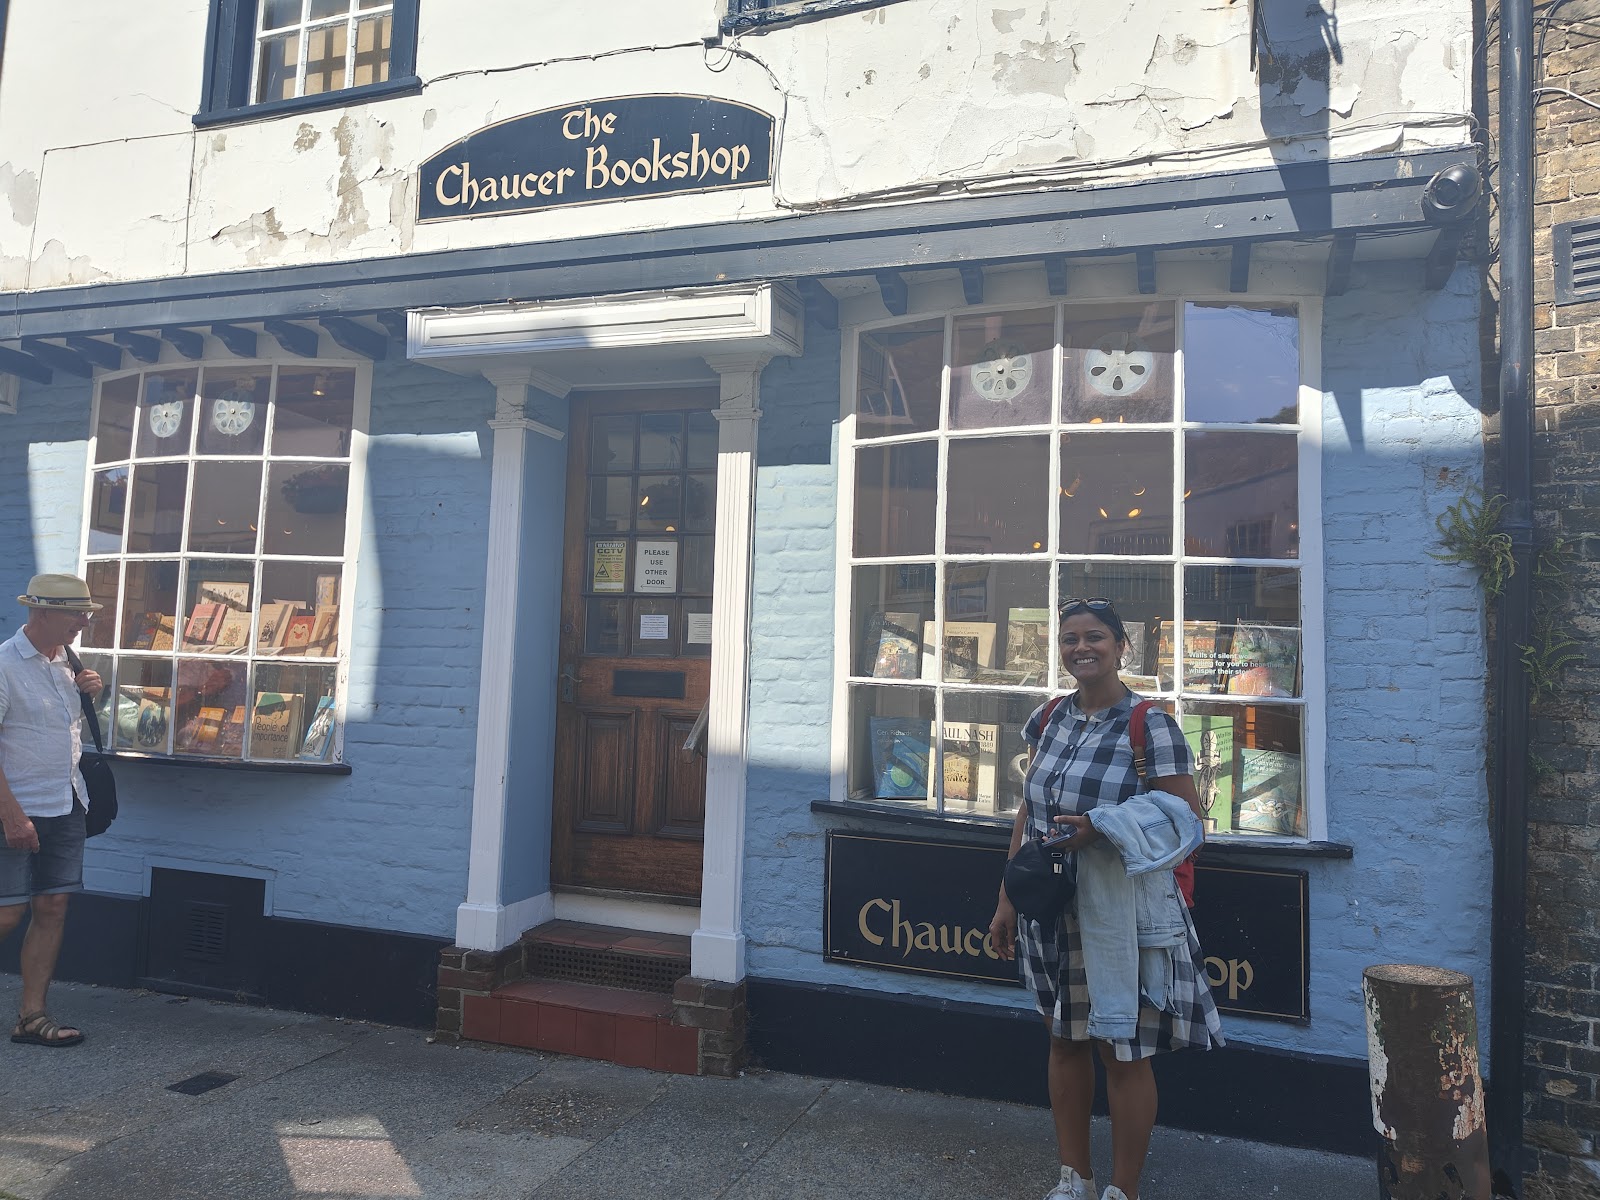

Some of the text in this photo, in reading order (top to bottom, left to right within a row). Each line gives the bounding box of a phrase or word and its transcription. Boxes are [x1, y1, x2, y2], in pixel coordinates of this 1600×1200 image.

[561, 107, 618, 144] The
[435, 132, 750, 210] Chaucer Bookshop
[1226, 661, 1240, 669] you
[254, 716, 290, 733] People of
[943, 727, 962, 739] AUL
[964, 728, 994, 742] NASH
[857, 897, 1001, 960] Chauce
